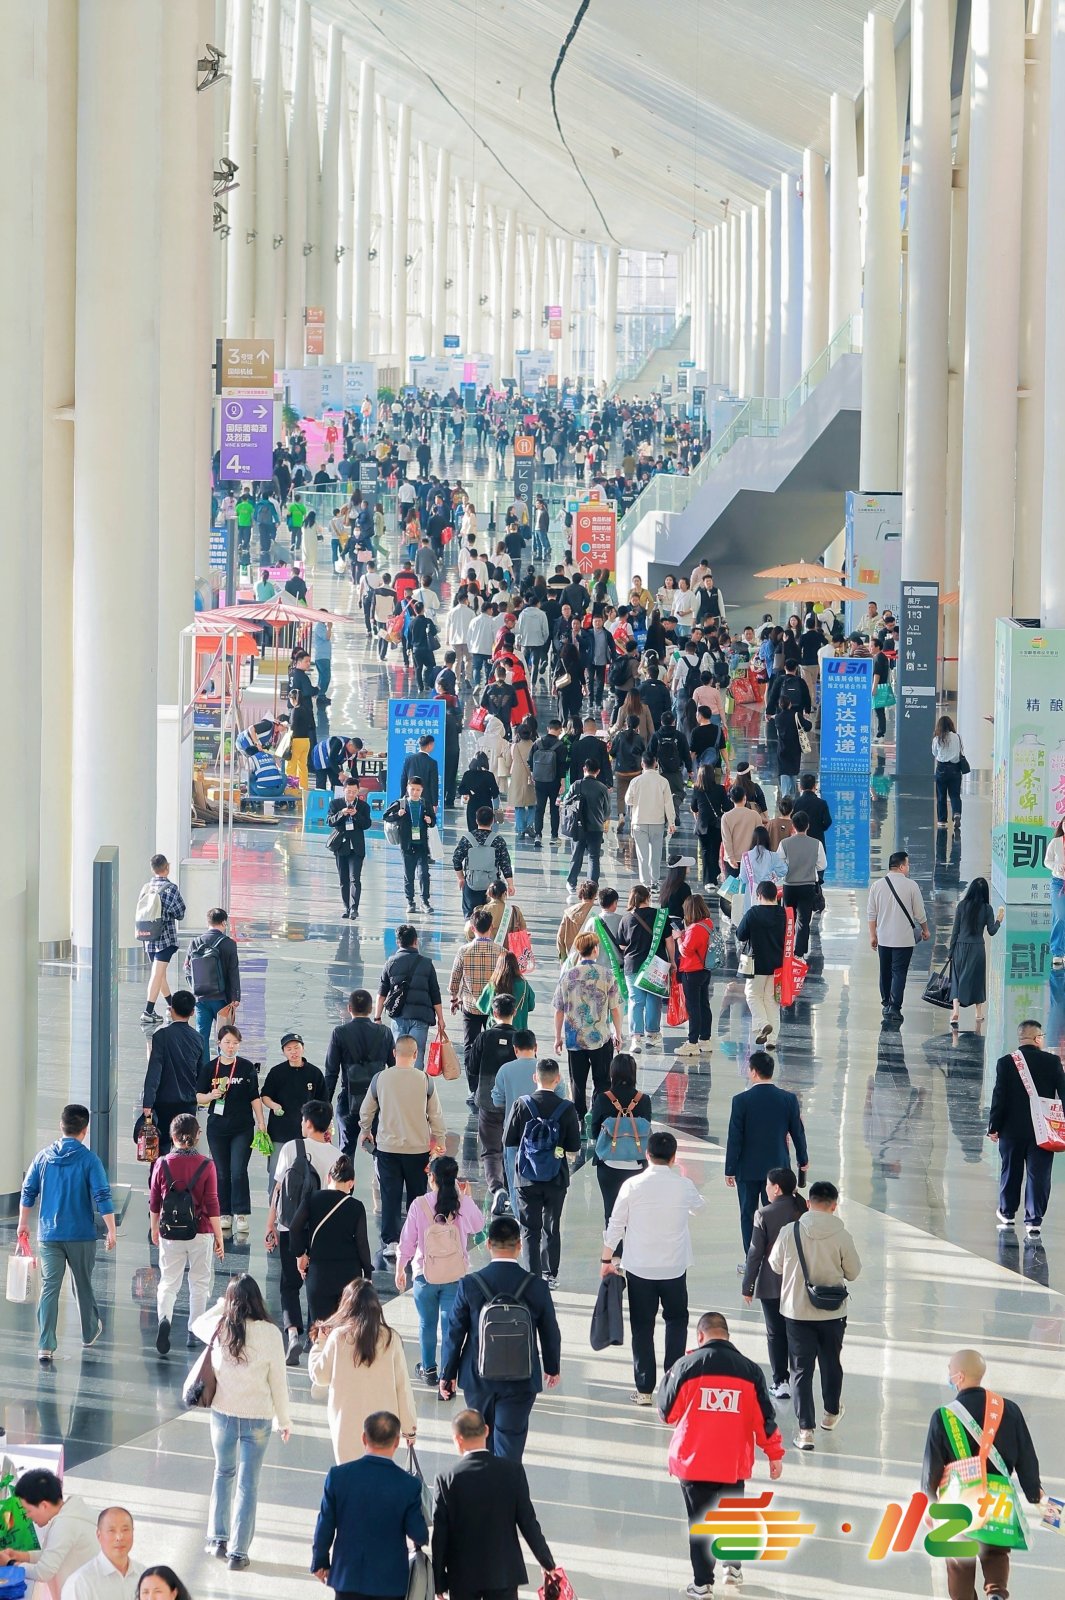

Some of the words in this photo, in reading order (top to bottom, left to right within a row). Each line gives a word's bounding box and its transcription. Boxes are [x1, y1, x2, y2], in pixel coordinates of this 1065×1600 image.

[227, 348, 240, 365] 3
[225, 424, 268, 433] 国际葡萄酒
[225, 433, 251, 442] 及烈酒
[226, 454, 241, 473] 4
[907, 637, 913, 645] B
[905, 710, 910, 718] 4
[835, 692, 857, 754] 韵达快递
[1014, 815, 1043, 823] KAISER
